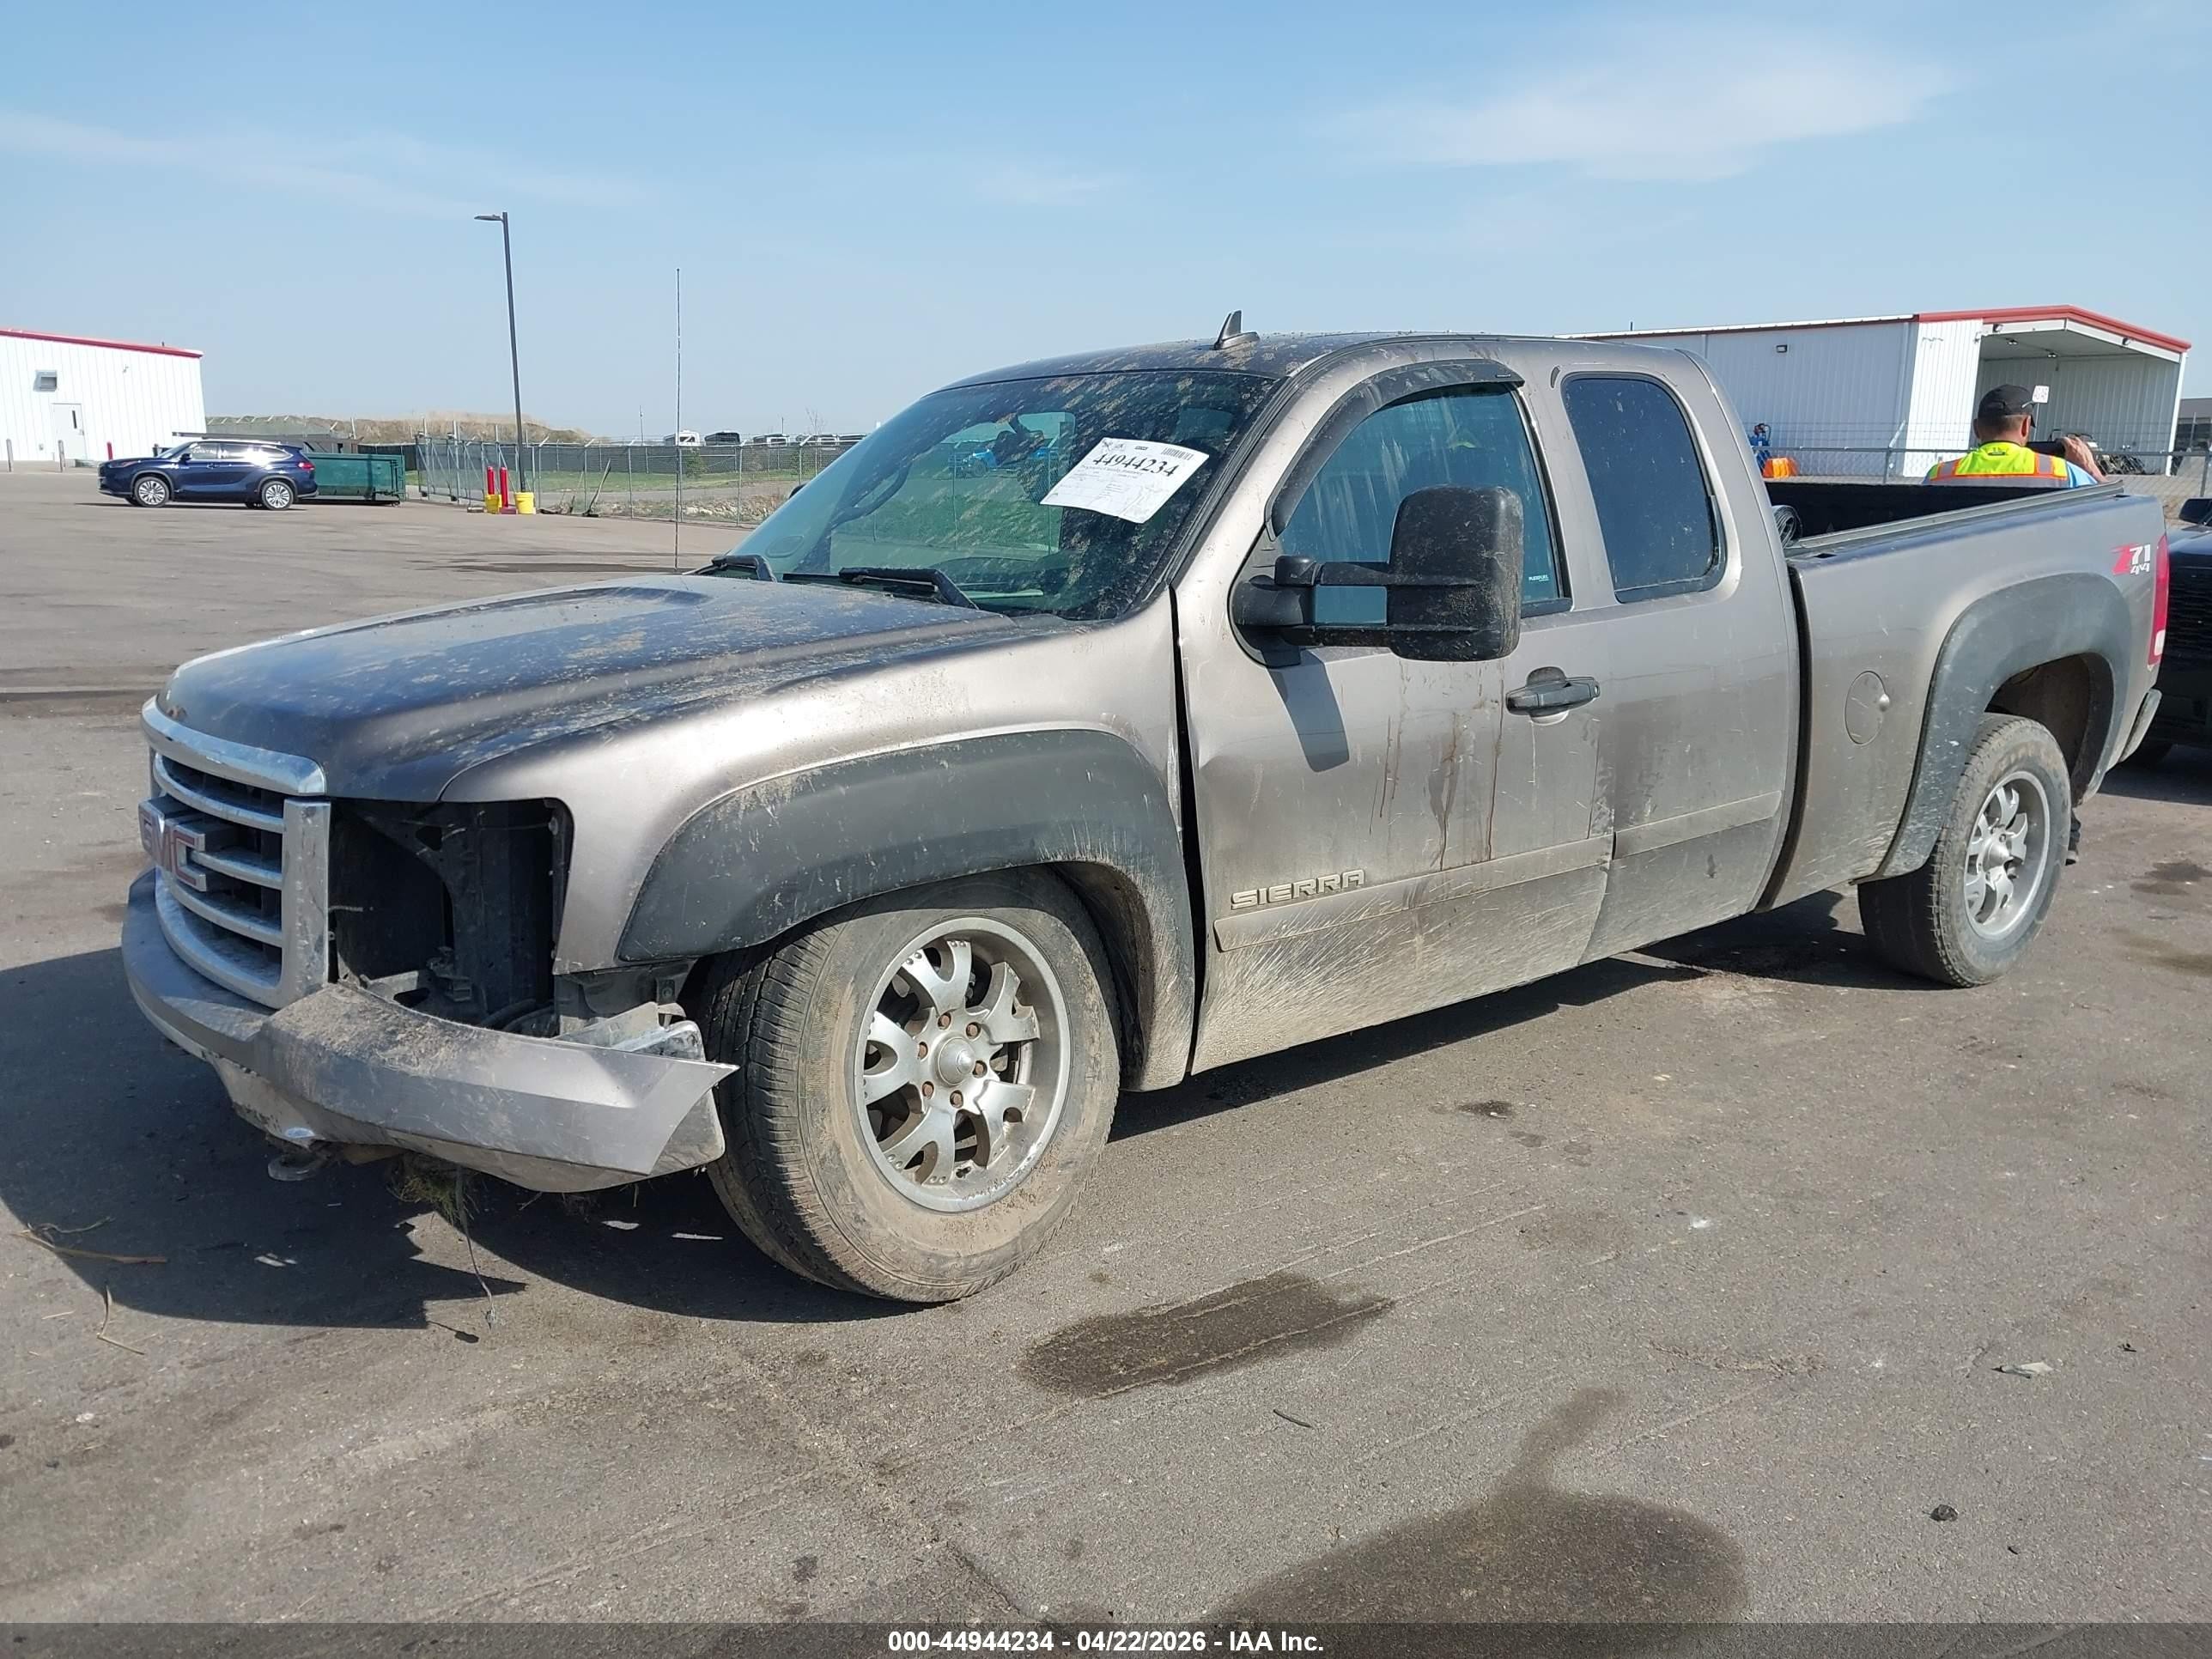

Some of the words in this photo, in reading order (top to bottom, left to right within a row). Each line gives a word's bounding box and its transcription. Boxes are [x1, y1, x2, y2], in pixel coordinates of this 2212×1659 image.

[1092, 453, 1179, 477] 44944234
[2110, 543, 2151, 575] Z71
[138, 802, 206, 891] GMC
[1231, 869, 1365, 910] SIERRA
